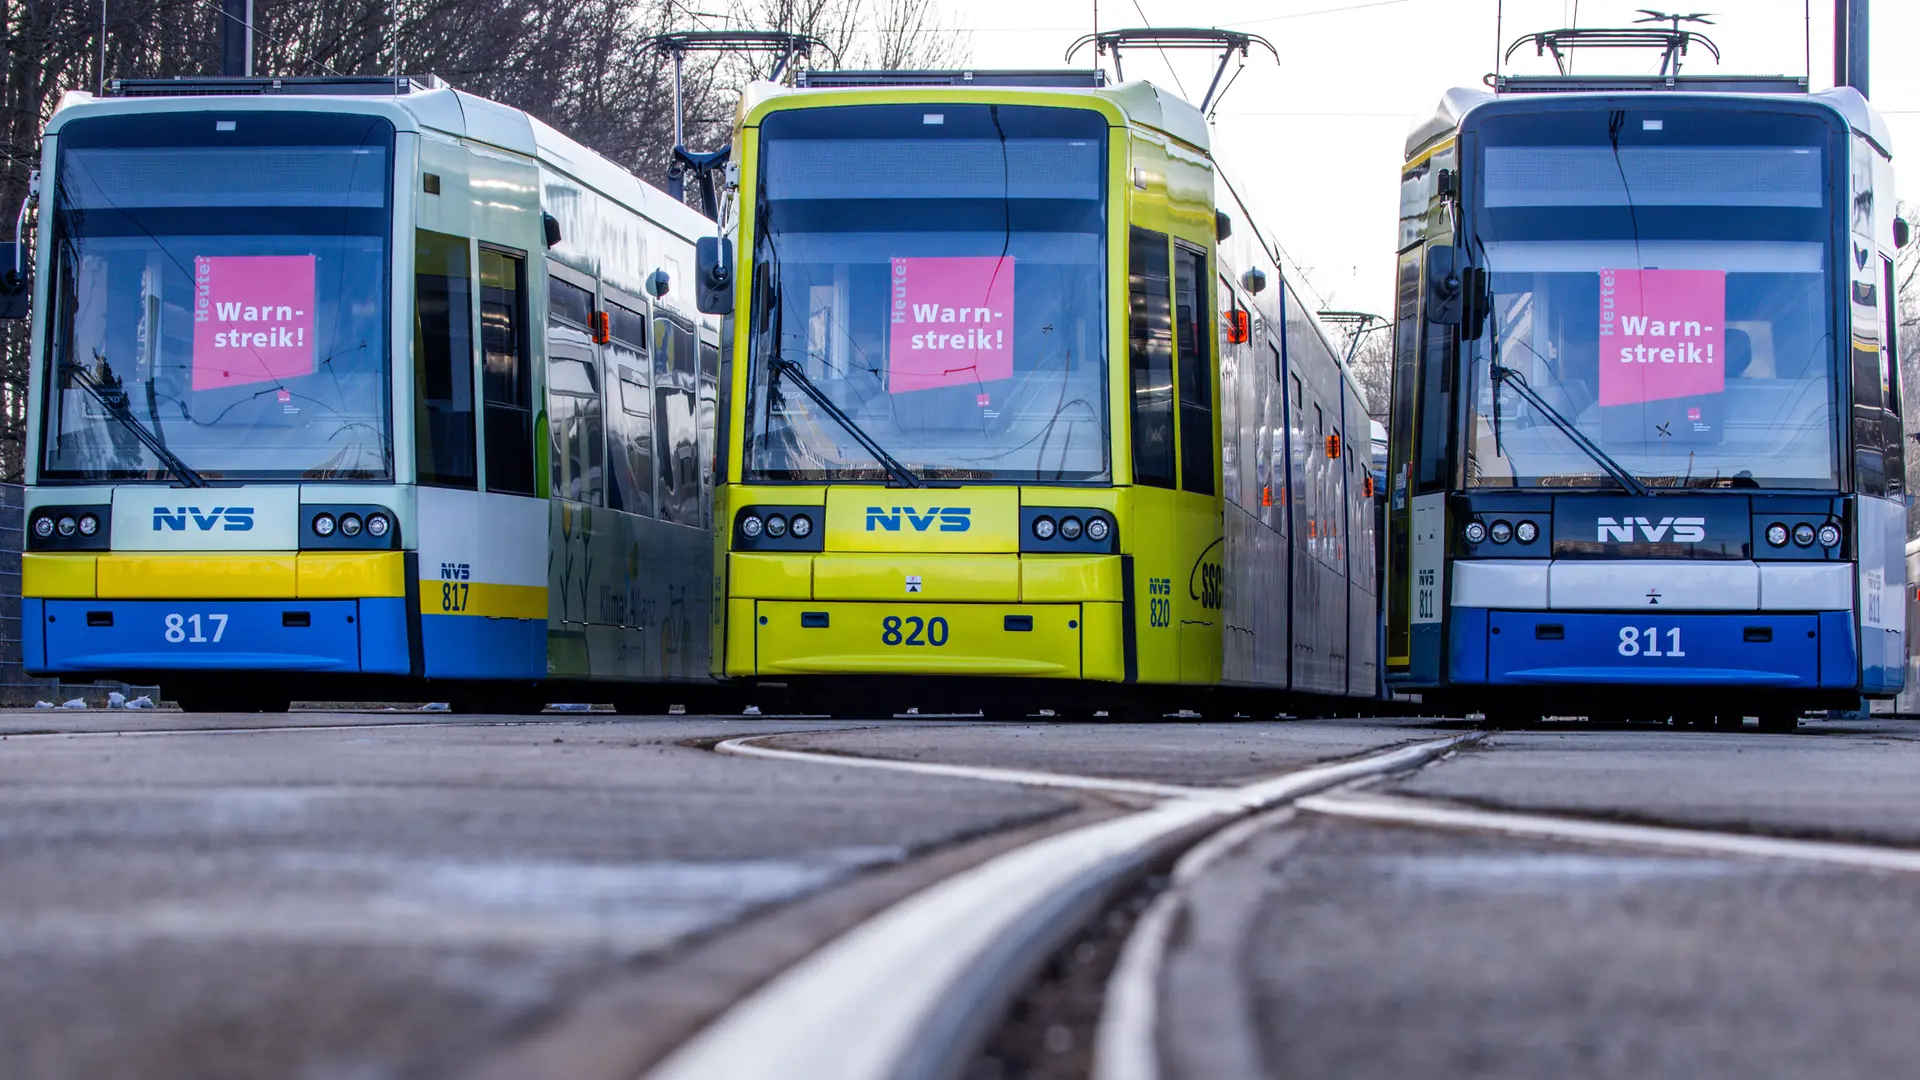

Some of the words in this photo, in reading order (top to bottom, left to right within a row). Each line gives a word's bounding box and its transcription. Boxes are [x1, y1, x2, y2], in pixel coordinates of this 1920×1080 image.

[195, 256, 210, 322] Heute:
[891, 258, 906, 323] Heute:
[215, 302, 304, 321] Warn-
[912, 303, 1003, 323] Warn-
[1600, 269, 1615, 336] Heute:
[214, 327, 304, 347] streik!
[911, 329, 1003, 349] streik!
[1621, 316, 1713, 336] Warn-
[1620, 342, 1714, 363] streik!
[153, 506, 254, 531] NVS
[866, 506, 971, 532] NVS
[1597, 516, 1705, 543] NVS
[441, 562, 470, 580] NVS
[442, 582, 469, 611] 817
[1149, 578, 1170, 595] NVS
[1150, 598, 1170, 628] 820
[1419, 589, 1433, 618] 811
[165, 613, 229, 643] 817
[881, 615, 949, 647] 820
[1618, 626, 1686, 657] 811
